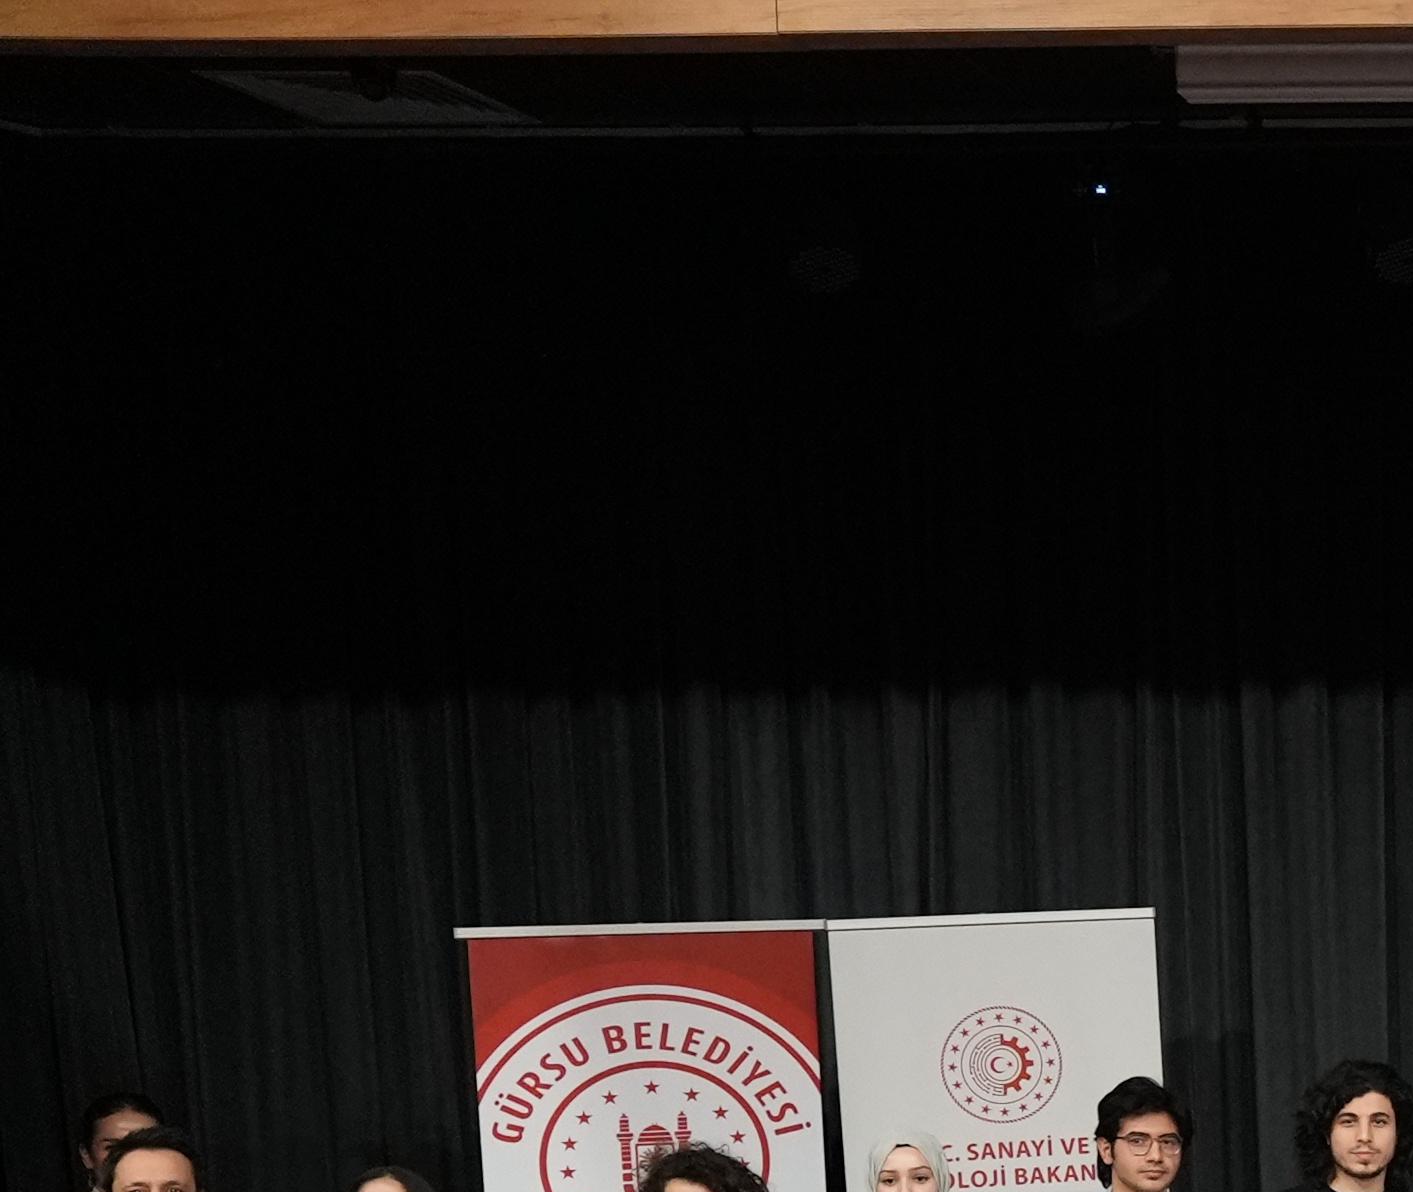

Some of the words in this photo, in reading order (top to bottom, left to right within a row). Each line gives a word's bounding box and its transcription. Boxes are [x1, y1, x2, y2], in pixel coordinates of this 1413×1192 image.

[492, 1037, 591, 1143] GÜRSU
[601, 1022, 812, 1136] BELEDİYESİ
[967, 1135, 1052, 1161] SANAYİ
[1060, 1137, 1090, 1155] VE
[1014, 1164, 1097, 1186] BAKAN
